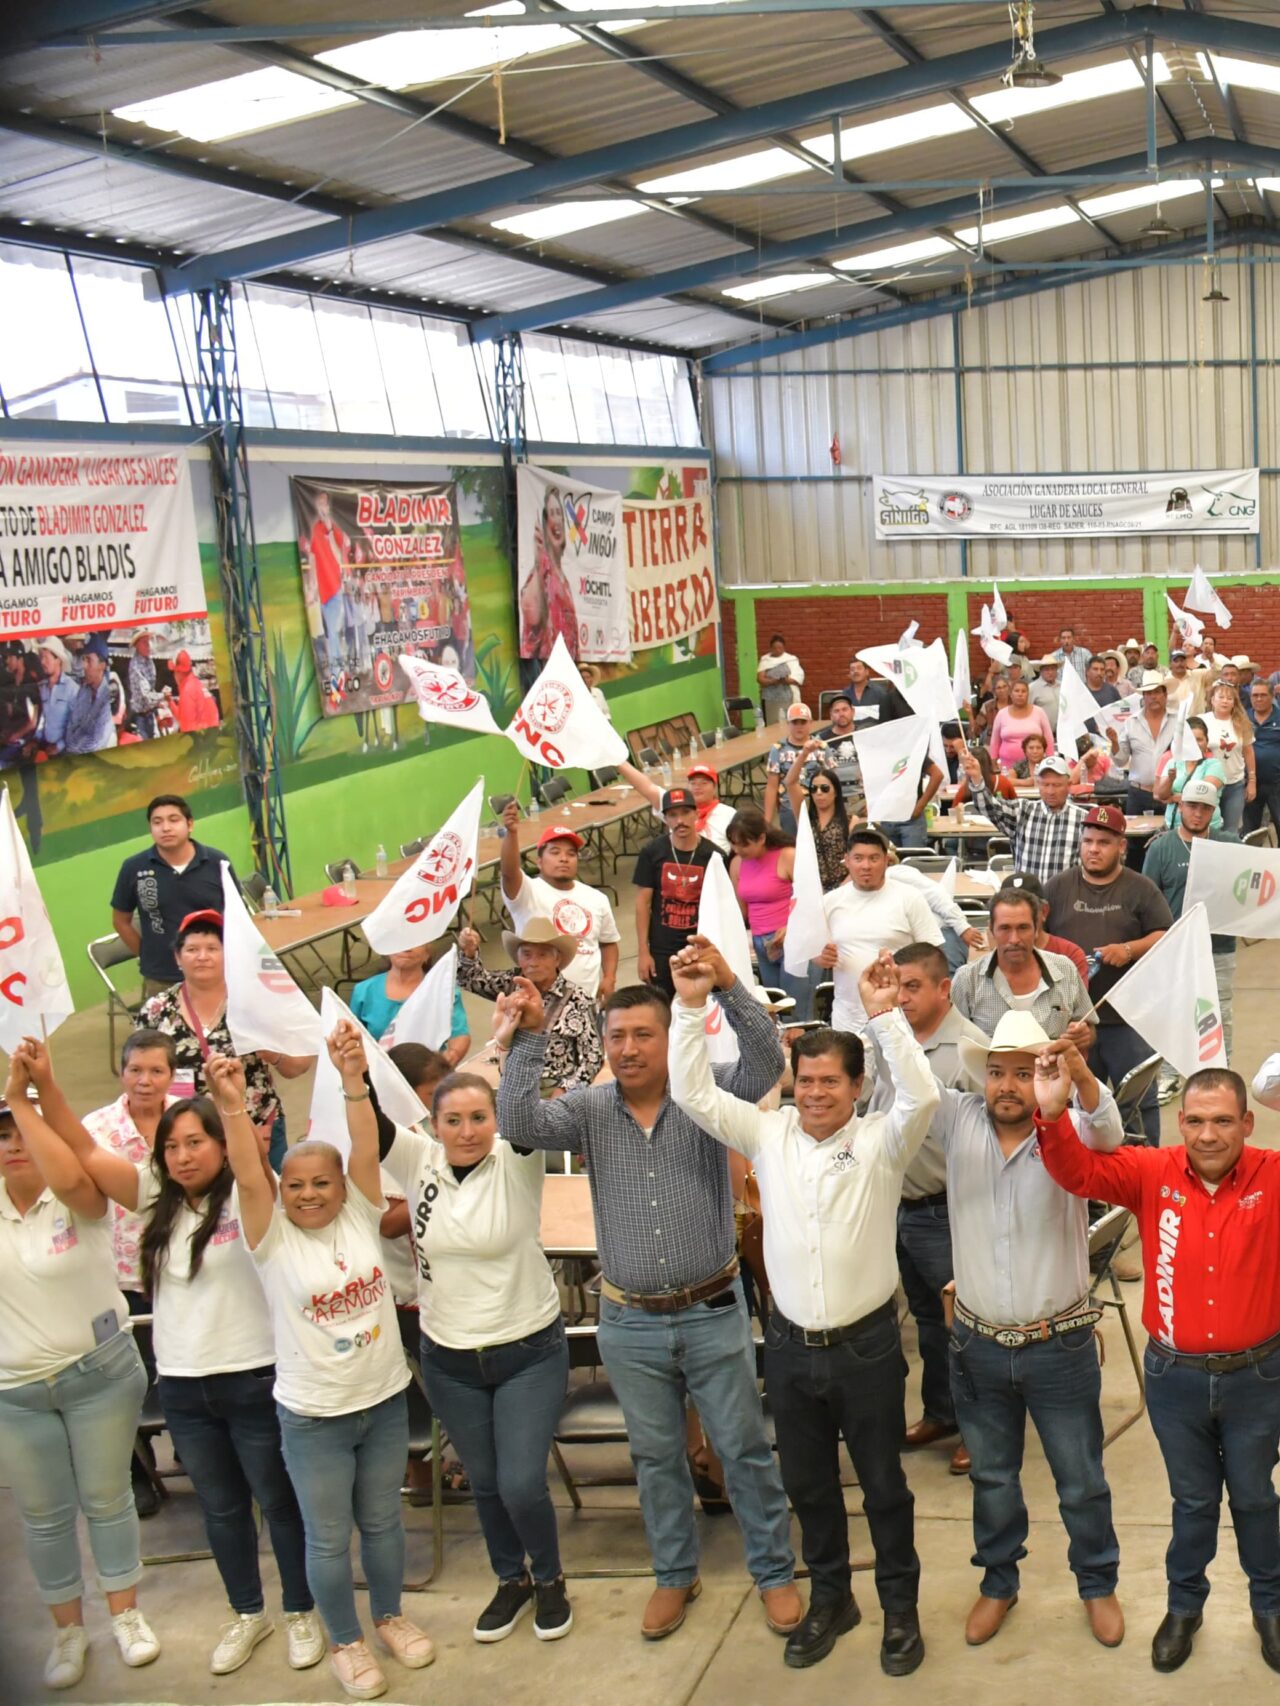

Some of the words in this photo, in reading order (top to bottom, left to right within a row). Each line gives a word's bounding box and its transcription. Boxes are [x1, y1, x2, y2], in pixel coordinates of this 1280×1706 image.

[17, 455, 81, 486] GANADERA
[126, 457, 140, 485] DE
[982, 481, 1033, 497] ASOCIACIÓN
[1034, 482, 1081, 497] GANADERA
[1082, 482, 1108, 496] LOCAL
[1110, 481, 1149, 496] GENERAL
[19, 506, 36, 537] DE
[37, 504, 92, 536] BLADIMIR
[357, 494, 452, 526] BLADIMIR
[1029, 504, 1056, 519] LUGAR
[1057, 504, 1070, 518] DE
[1072, 503, 1103, 518] SAUCES
[1229, 505, 1255, 517] CNG
[373, 534, 443, 558] GONZALEZ
[623, 503, 707, 567] TIERRA
[13, 545, 72, 587] AMIGO
[76, 543, 136, 582] BLADIS
[135, 585, 178, 597] #HAGAMOS
[579, 575, 612, 597] XÓCHITL
[62, 592, 113, 605] #HAGAMOS
[134, 595, 179, 615] FUTURO
[630, 566, 715, 643] IBERTAD
[62, 602, 116, 622] FUTURO
[1233, 868, 1276, 907] PRI
[1073, 900, 1122, 916] Champion
[312, 1266, 383, 1307] KARLA
